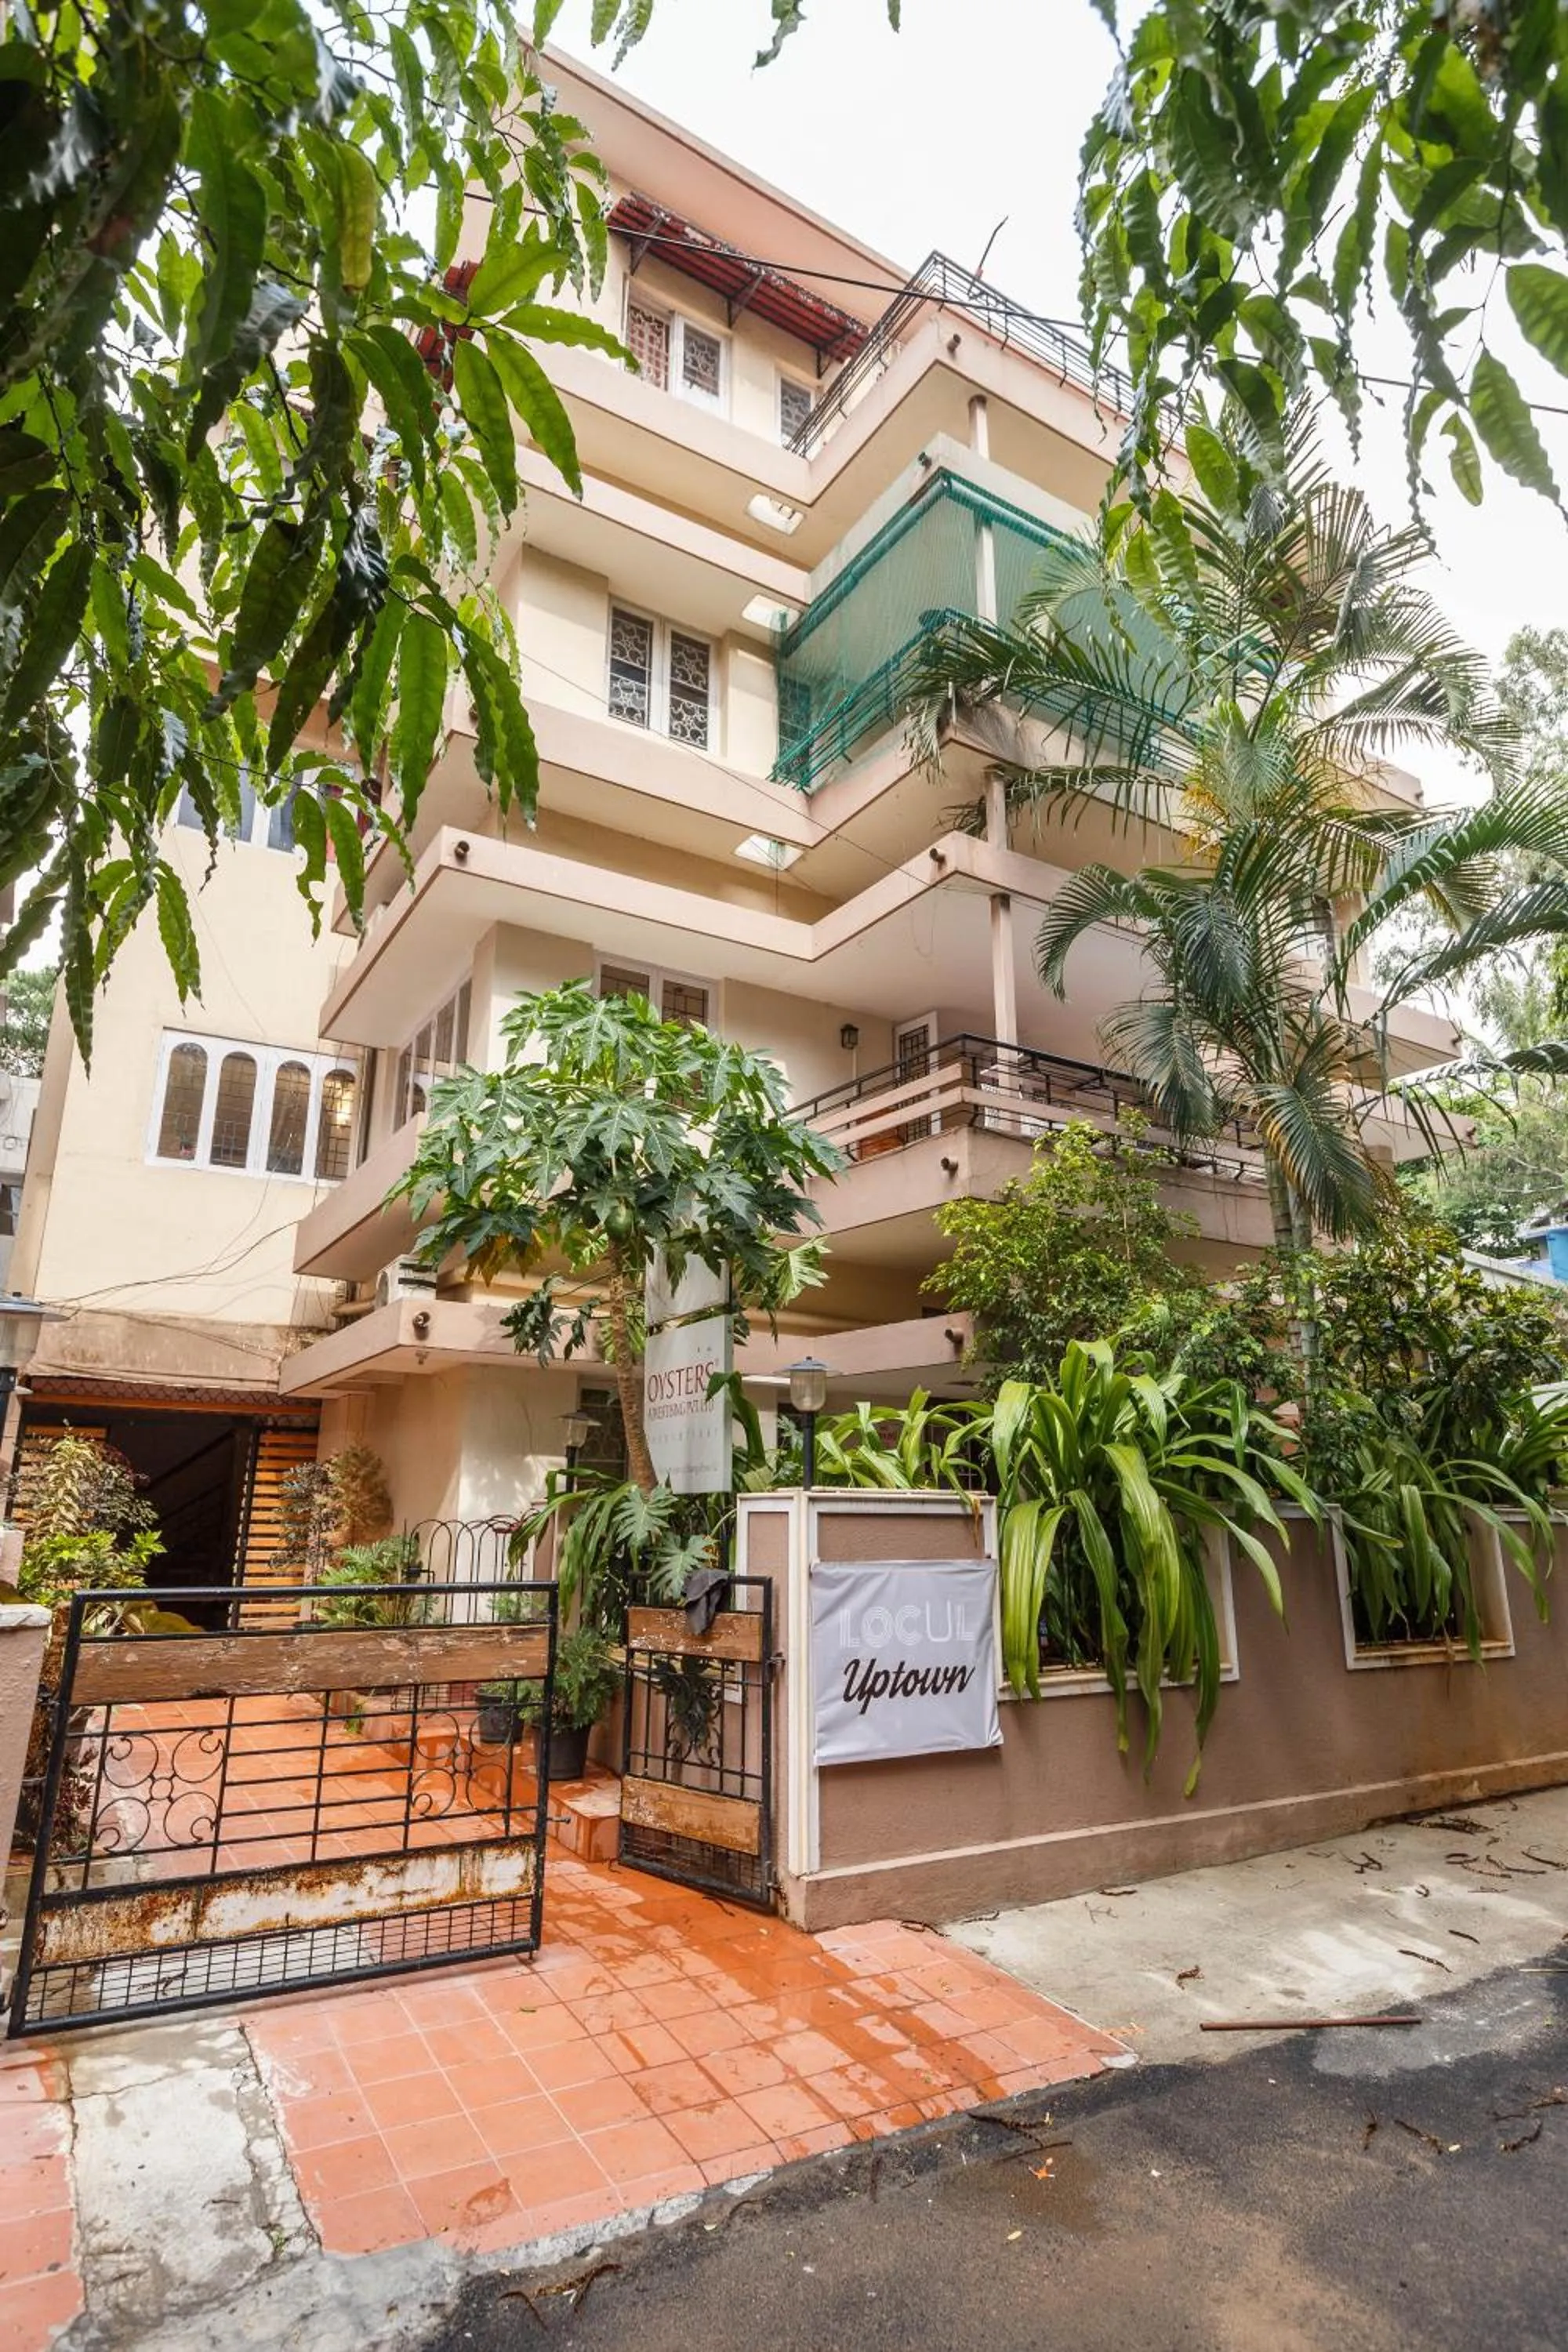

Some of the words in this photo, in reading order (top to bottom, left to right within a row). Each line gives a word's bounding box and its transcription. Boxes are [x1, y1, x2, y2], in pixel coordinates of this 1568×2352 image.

[647, 1361, 714, 1403] OYSTERS
[838, 1599, 975, 1648] LOCUL
[843, 1657, 976, 1715] Uptown
